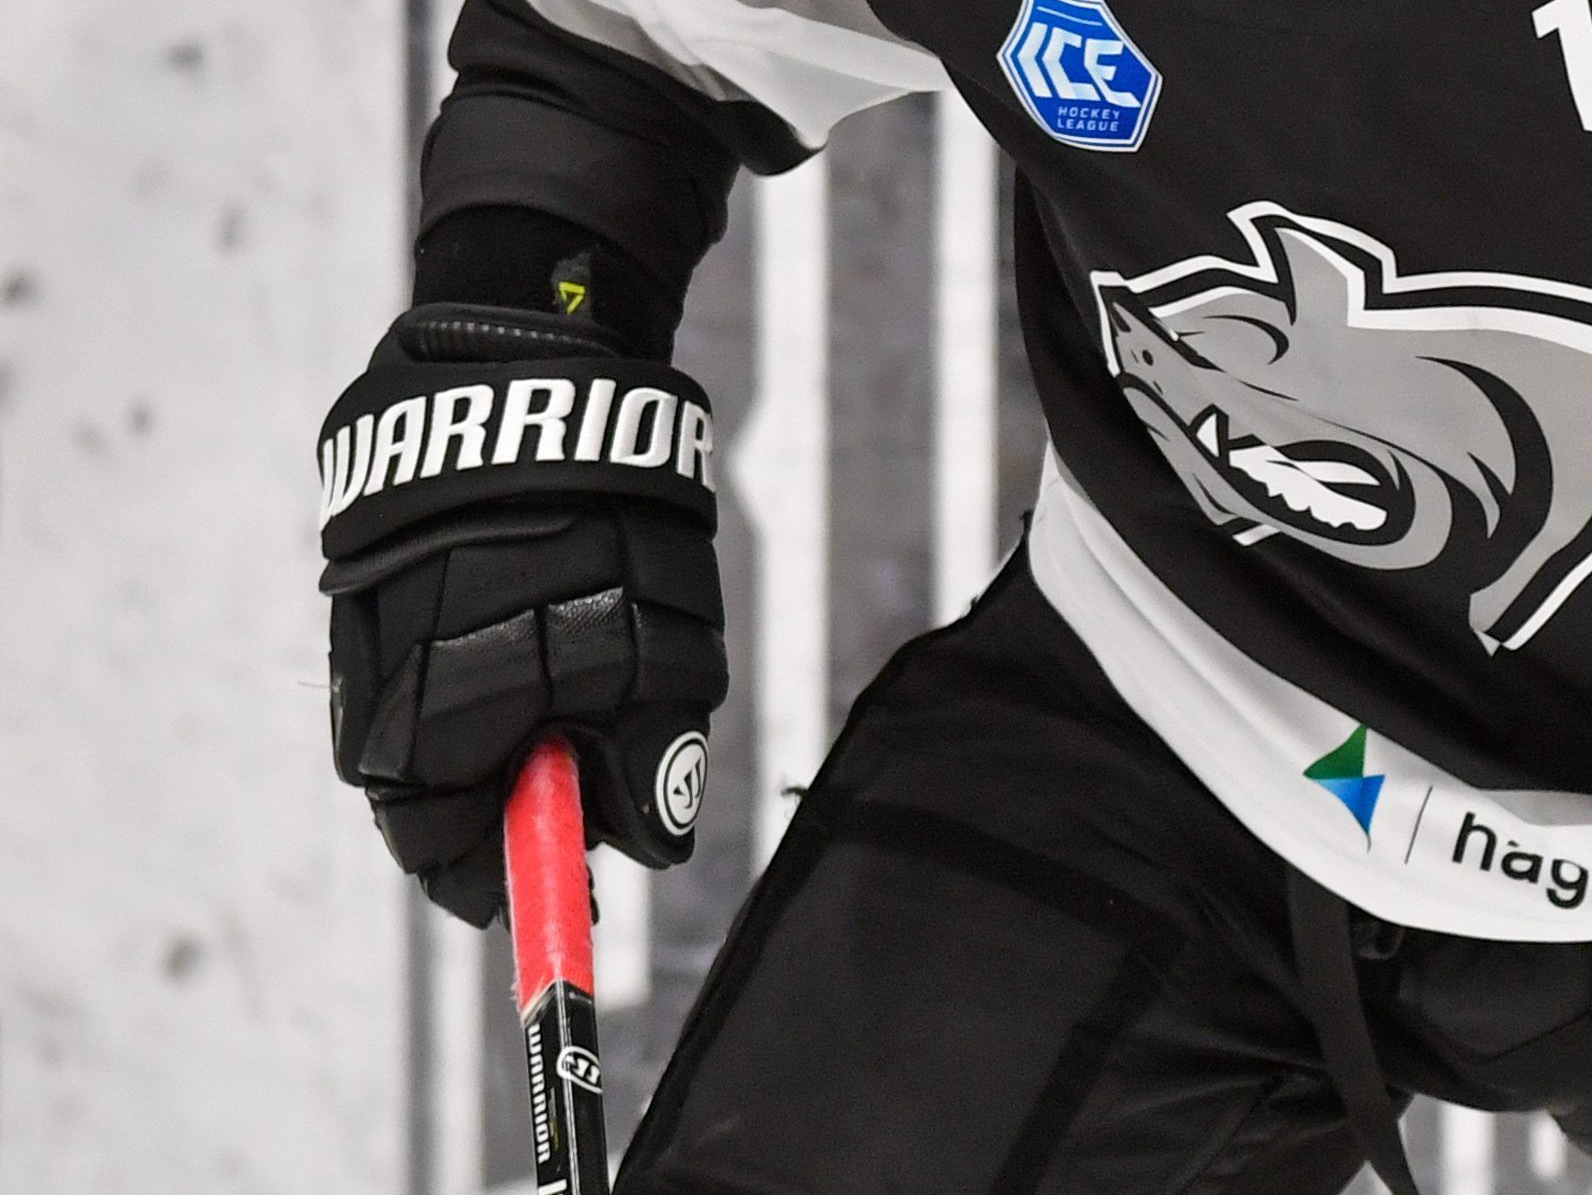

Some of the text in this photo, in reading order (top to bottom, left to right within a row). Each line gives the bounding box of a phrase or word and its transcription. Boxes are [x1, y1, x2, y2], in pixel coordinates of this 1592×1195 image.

[1017, 22, 1142, 108] ICE
[1057, 106, 1121, 120] HOCKEY
[1057, 118, 1120, 132] LEAGUE
[319, 379, 717, 532] WARRIOR
[527, 1022, 551, 1165] WARRIOR
